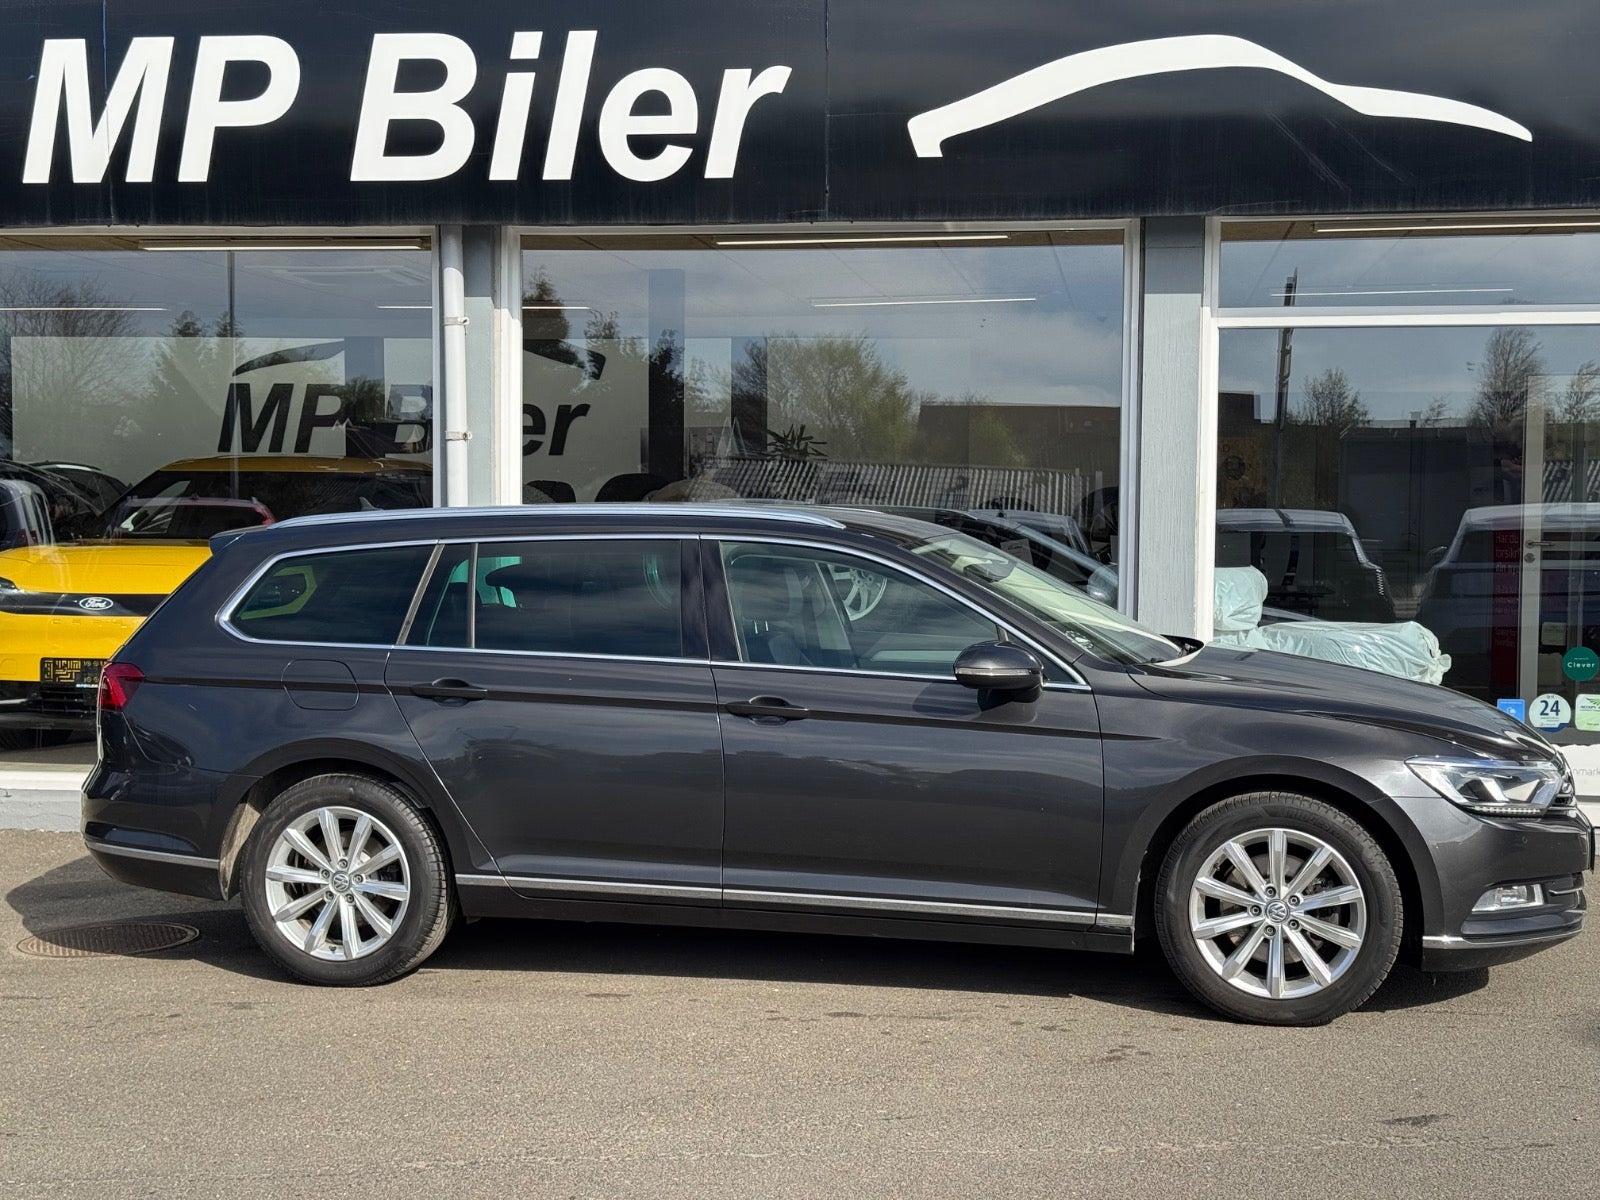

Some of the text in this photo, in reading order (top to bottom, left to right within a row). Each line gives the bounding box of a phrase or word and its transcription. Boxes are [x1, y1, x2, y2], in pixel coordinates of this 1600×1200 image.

[22, 29, 793, 184] MP Biler
[217, 383, 354, 453] MP
[84, 598, 107, 608] Ford
[1539, 699, 1561, 716] 24
